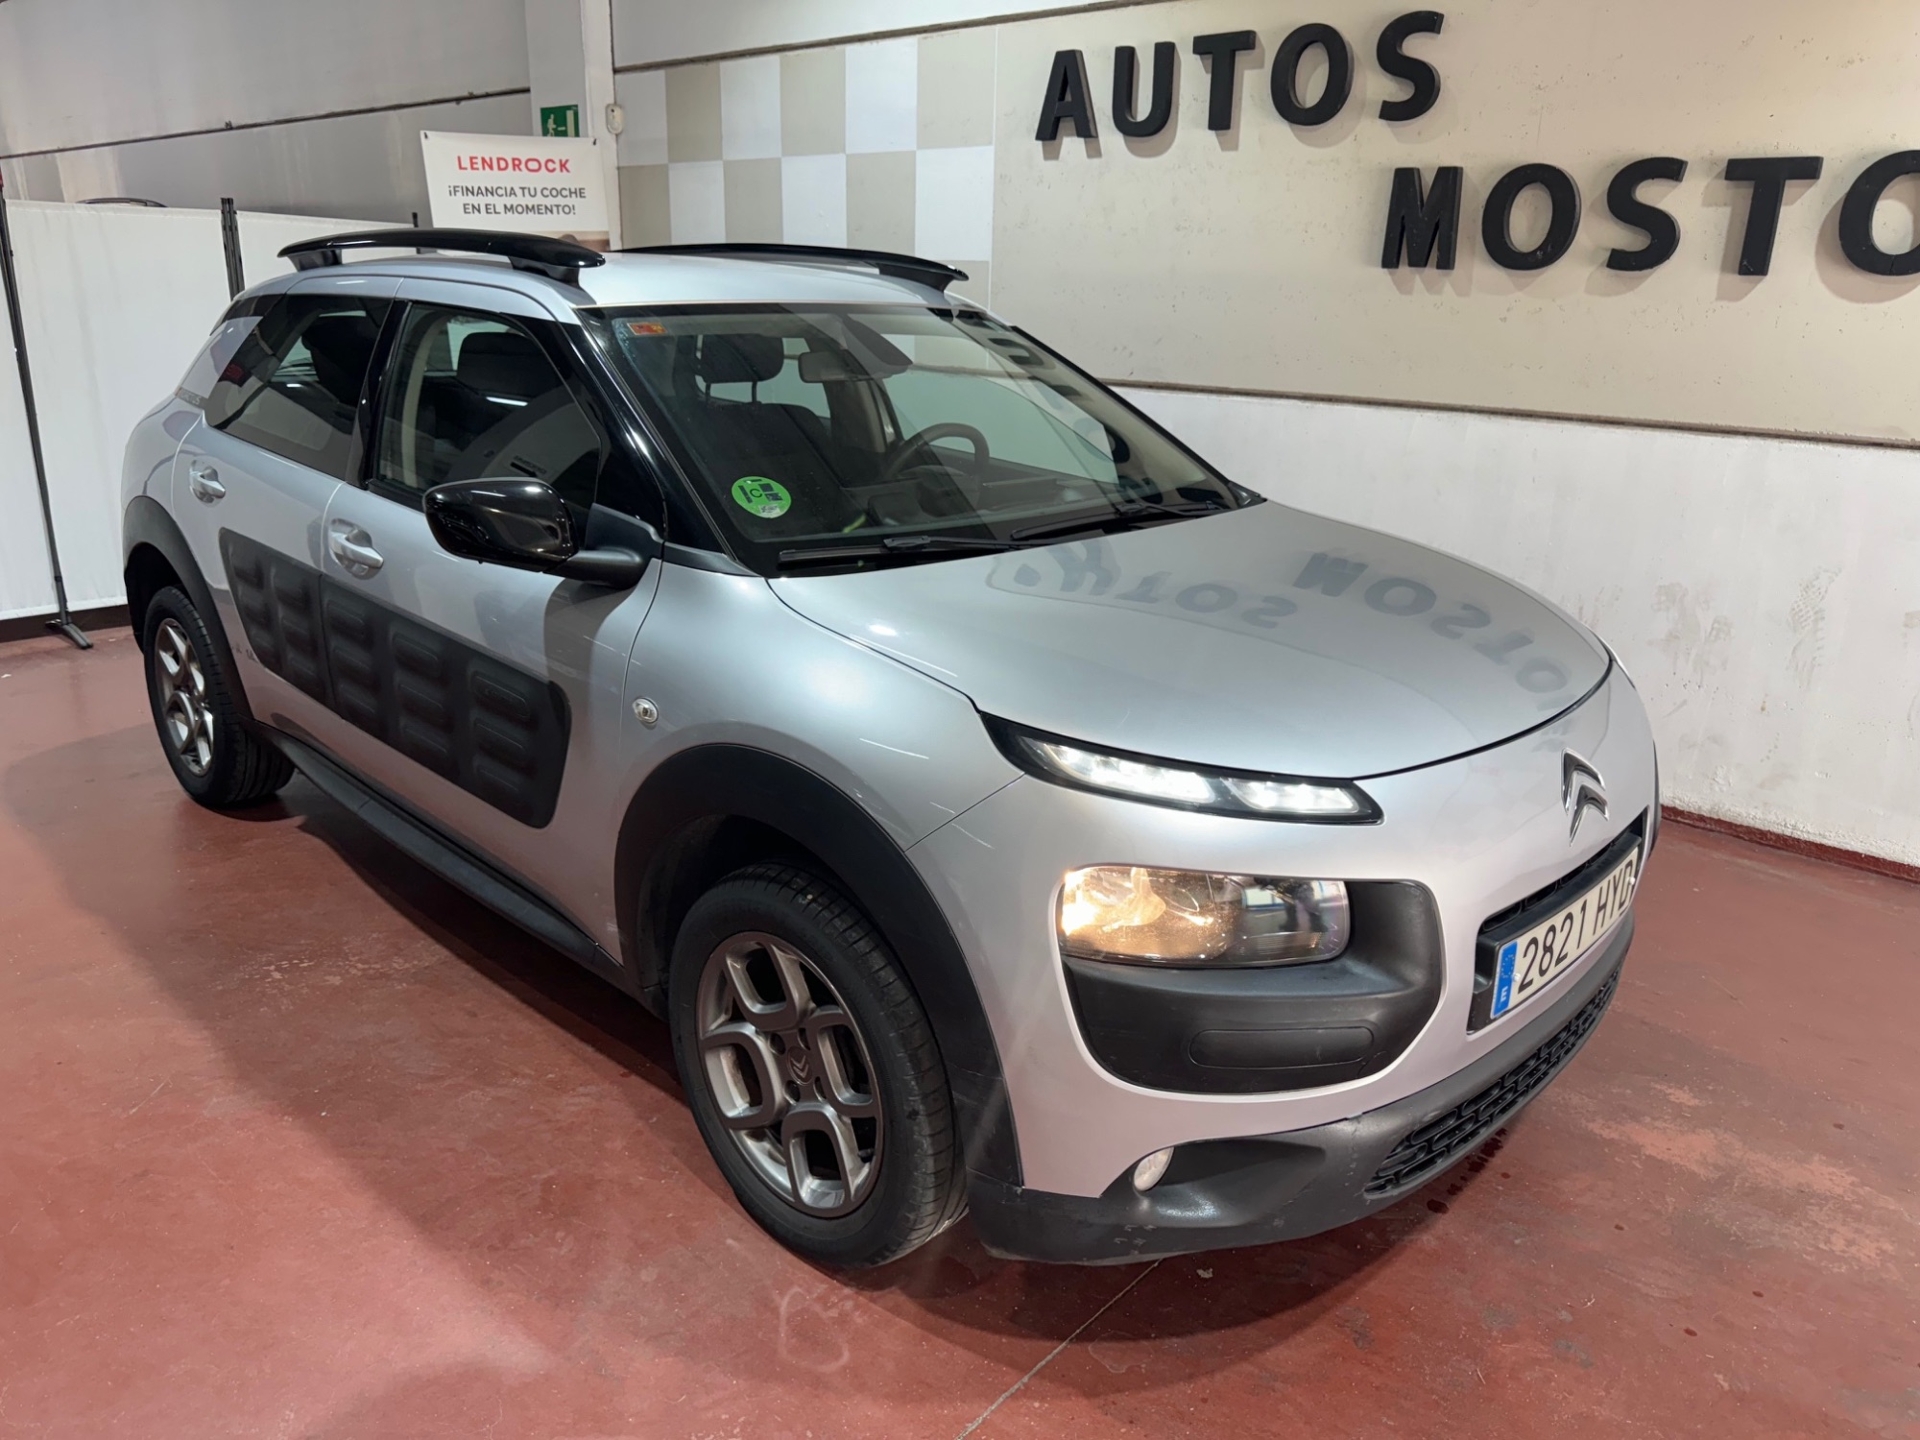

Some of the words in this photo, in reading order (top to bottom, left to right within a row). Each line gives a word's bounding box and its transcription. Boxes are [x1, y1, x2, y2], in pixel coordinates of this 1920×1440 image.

[1035, 10, 1445, 141] AUTOS
[448, 185, 517, 199] ¡FINANCIA
[519, 186, 537, 199] TU
[540, 187, 586, 199] COCHE
[457, 155, 571, 173] LENDROCK
[463, 203, 481, 215] EN
[485, 203, 501, 215] EL
[504, 203, 576, 216] MOMENTO!
[1381, 150, 1920, 276] MOSTO
[1518, 899, 1588, 994] 2821
[1593, 859, 1634, 936] HYD
